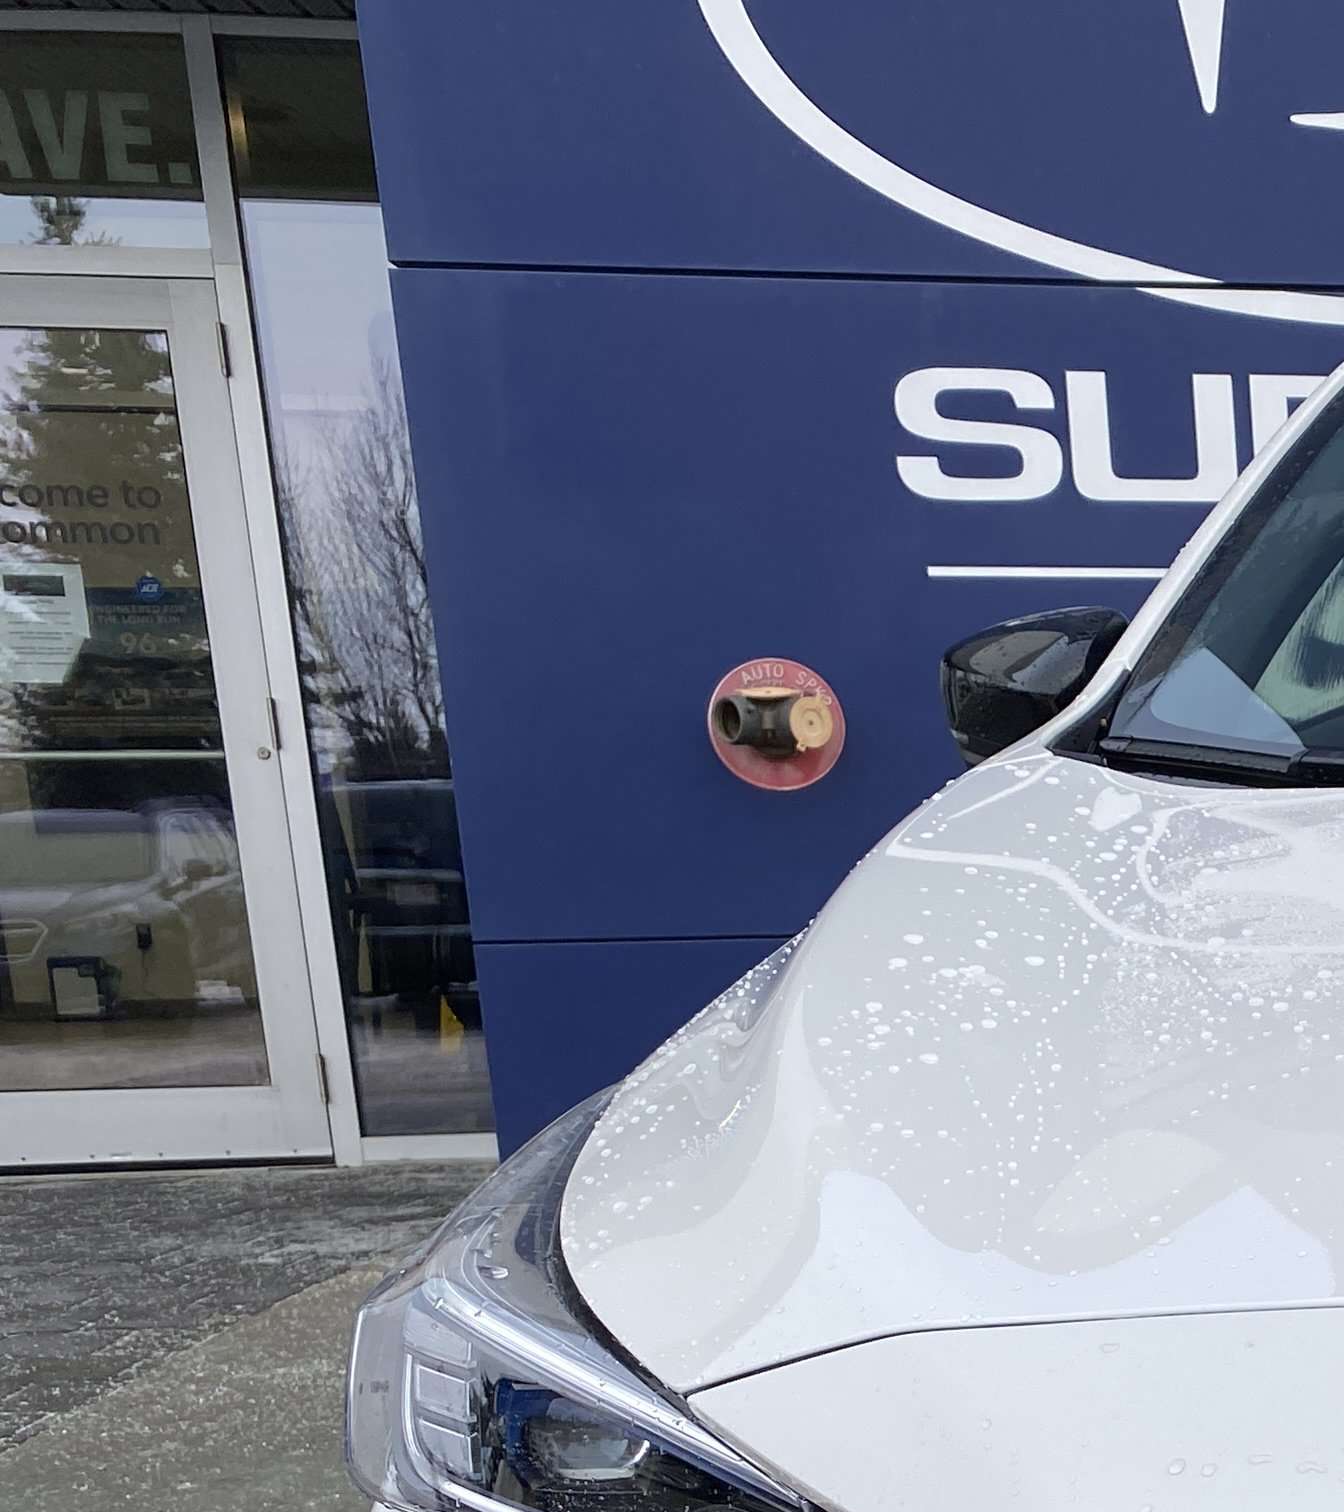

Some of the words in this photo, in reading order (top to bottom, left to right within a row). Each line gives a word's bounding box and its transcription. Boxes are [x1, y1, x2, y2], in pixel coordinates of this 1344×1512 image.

[0, 484, 109, 508] come
[121, 480, 161, 509] to
[741, 663, 785, 685] AUTO
